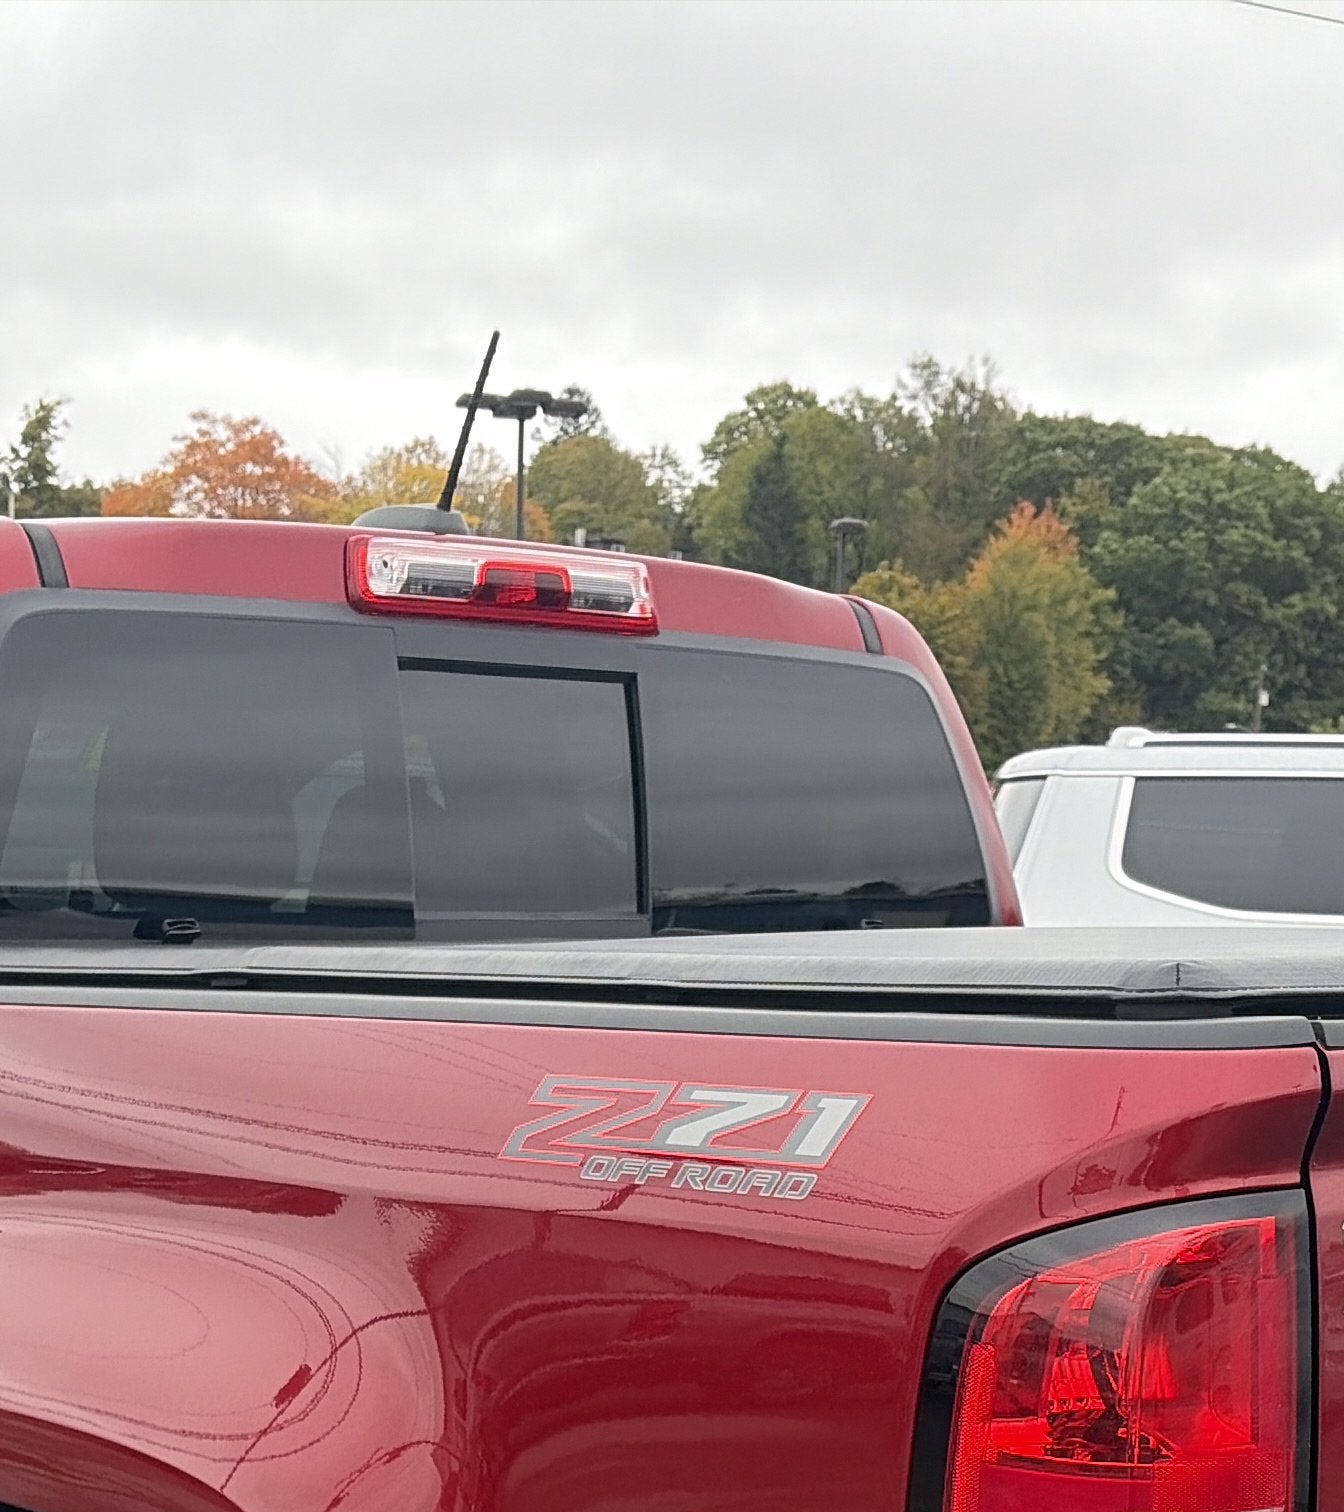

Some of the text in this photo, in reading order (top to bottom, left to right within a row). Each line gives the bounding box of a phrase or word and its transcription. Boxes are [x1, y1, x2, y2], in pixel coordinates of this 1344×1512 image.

[497, 1073, 874, 1168] Z71
[580, 1156, 818, 1200] OFF ROAD
